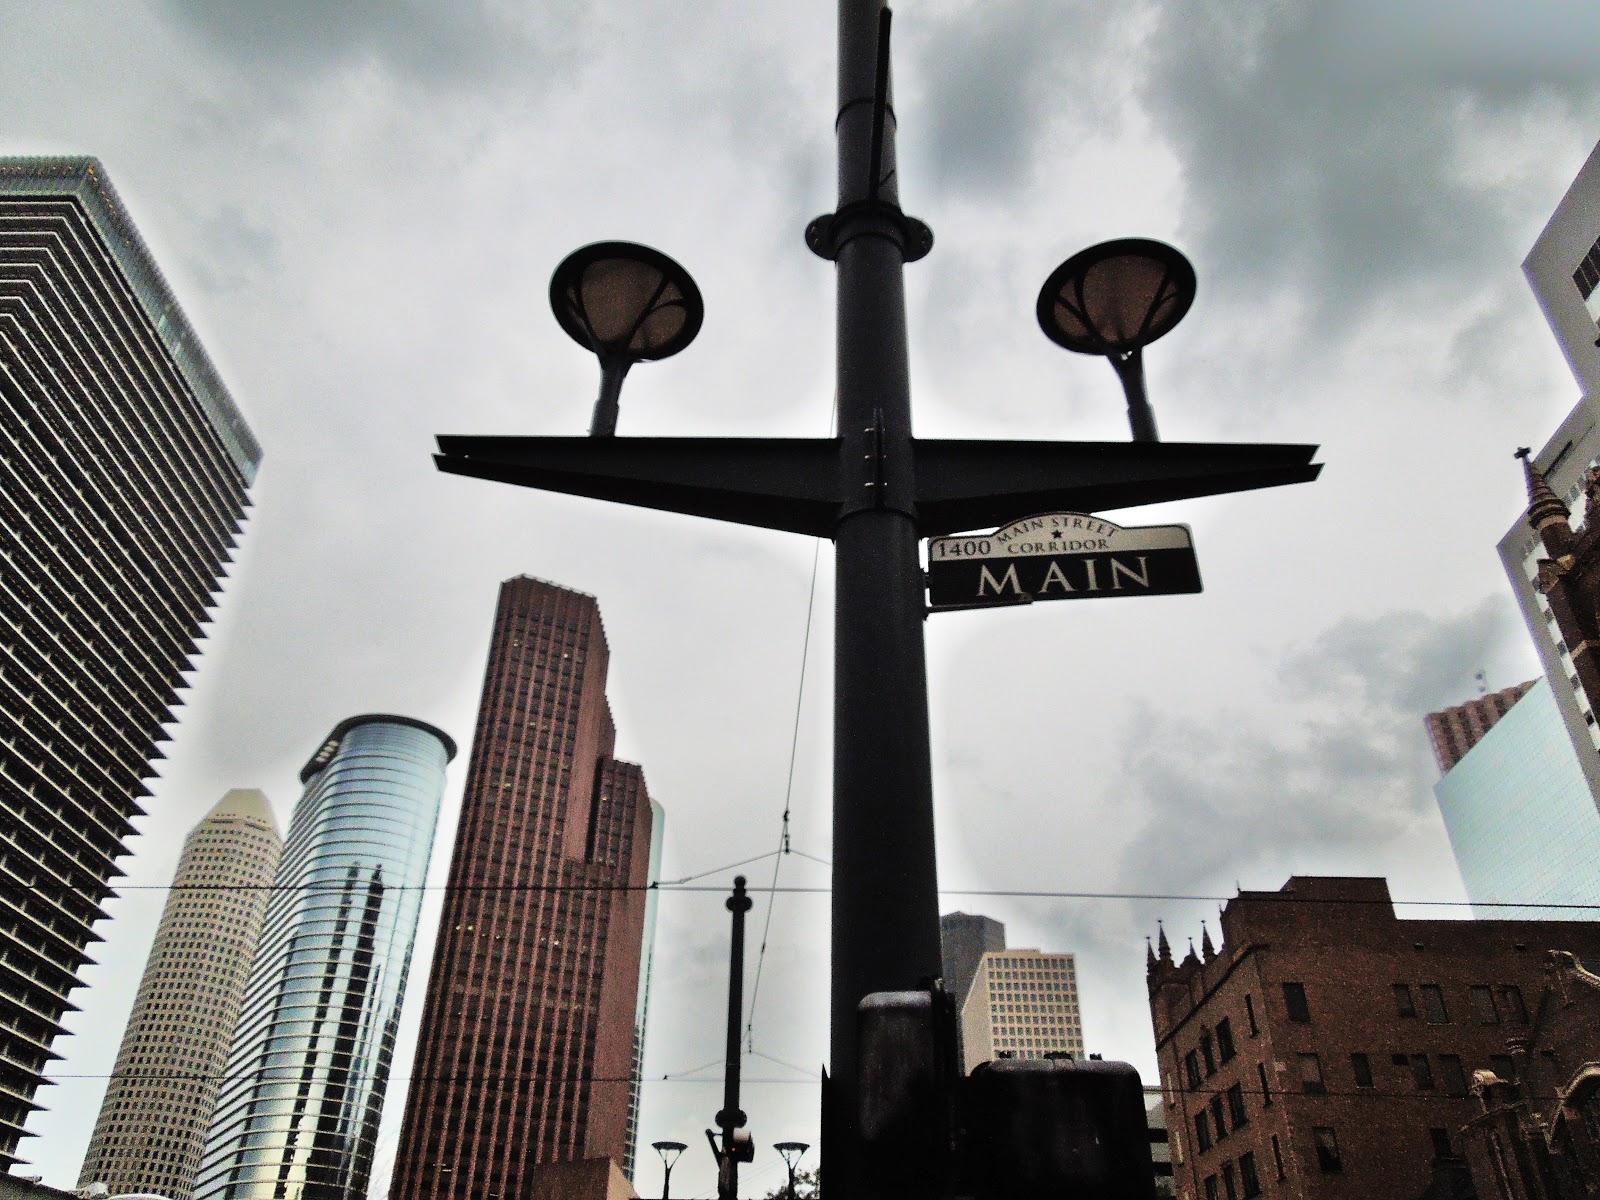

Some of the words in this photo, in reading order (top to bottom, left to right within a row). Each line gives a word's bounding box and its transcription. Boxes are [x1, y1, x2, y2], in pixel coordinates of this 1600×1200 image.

[996, 519, 1043, 544] MAIN
[1052, 517, 1119, 538] STREET
[937, 539, 992, 558] 1400
[1007, 538, 1111, 555] CORRIDOR
[975, 556, 1150, 597] MAIN
